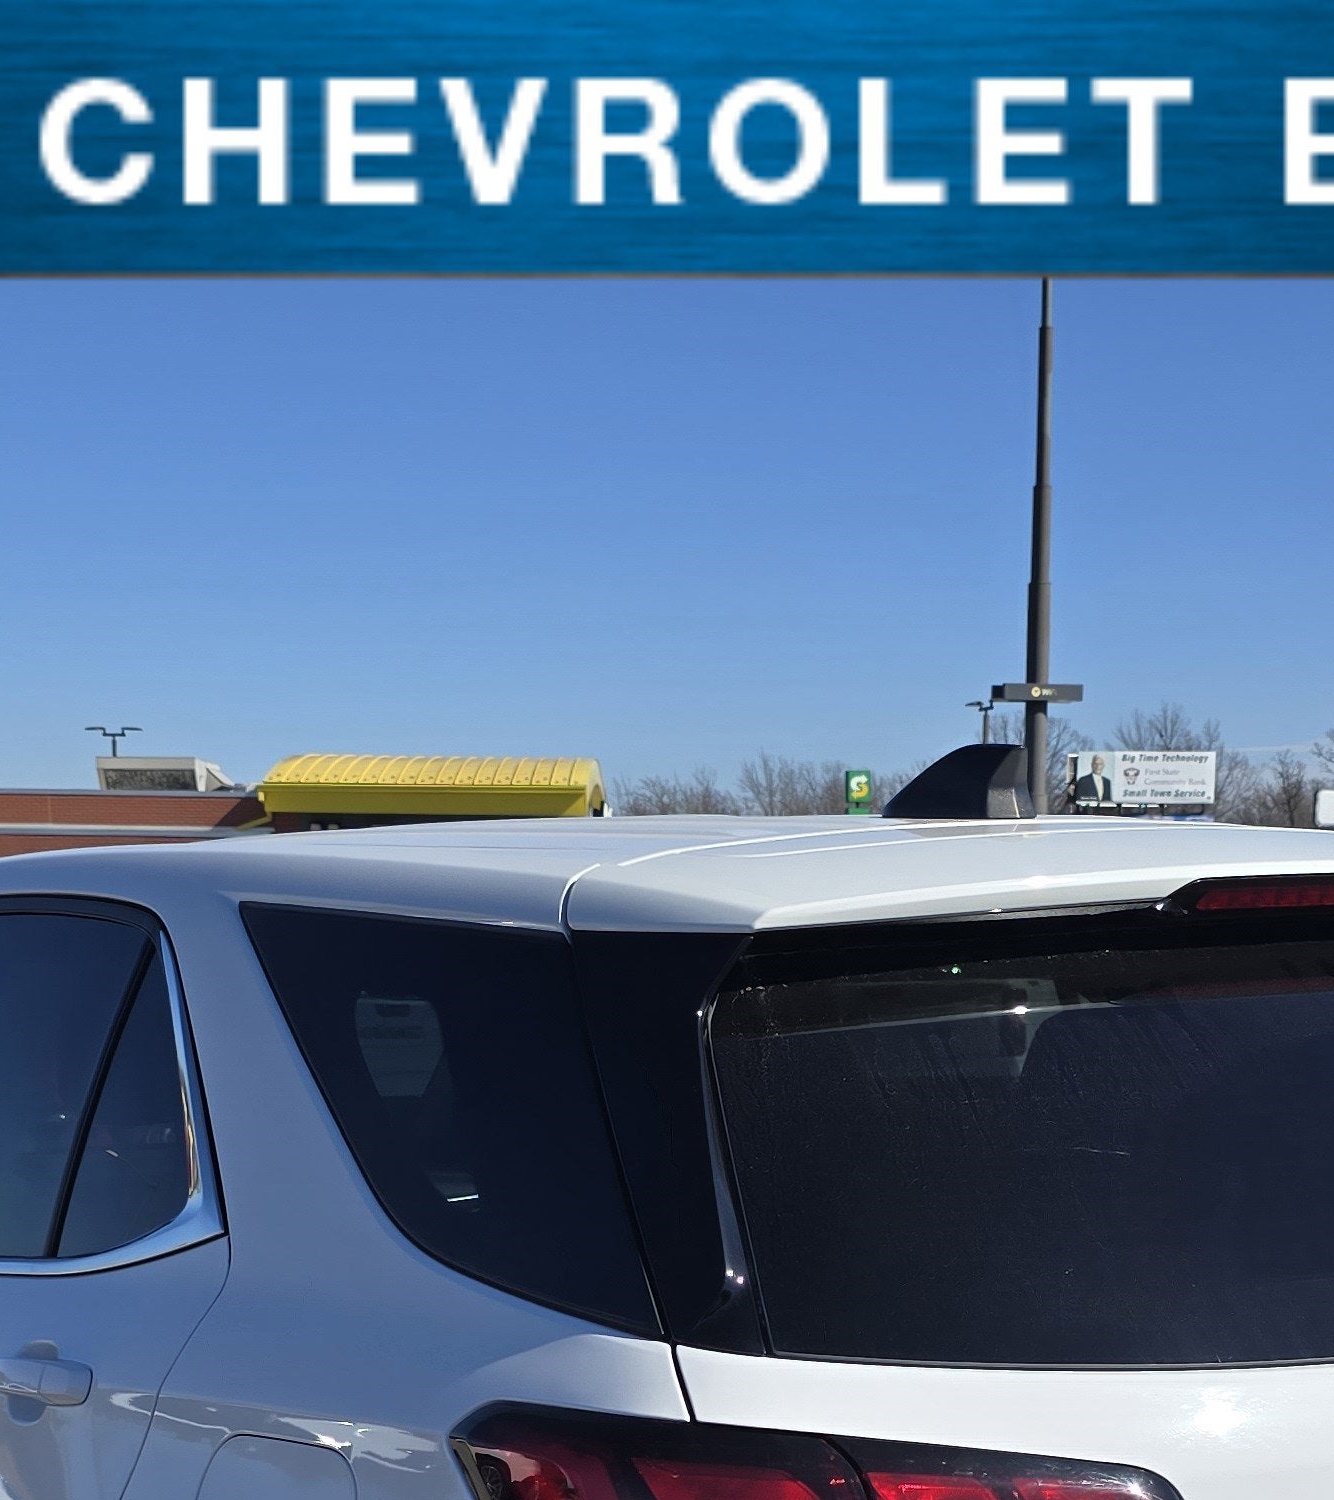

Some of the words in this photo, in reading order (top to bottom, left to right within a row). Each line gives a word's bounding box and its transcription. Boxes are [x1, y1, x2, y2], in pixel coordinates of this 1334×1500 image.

[1121, 754, 1136, 763] Big
[1139, 754, 1159, 762] Time
[1162, 754, 1209, 763] Technology
[1123, 789, 1147, 797] Small
[1150, 789, 1171, 797] Town
[1174, 789, 1206, 797] Service
